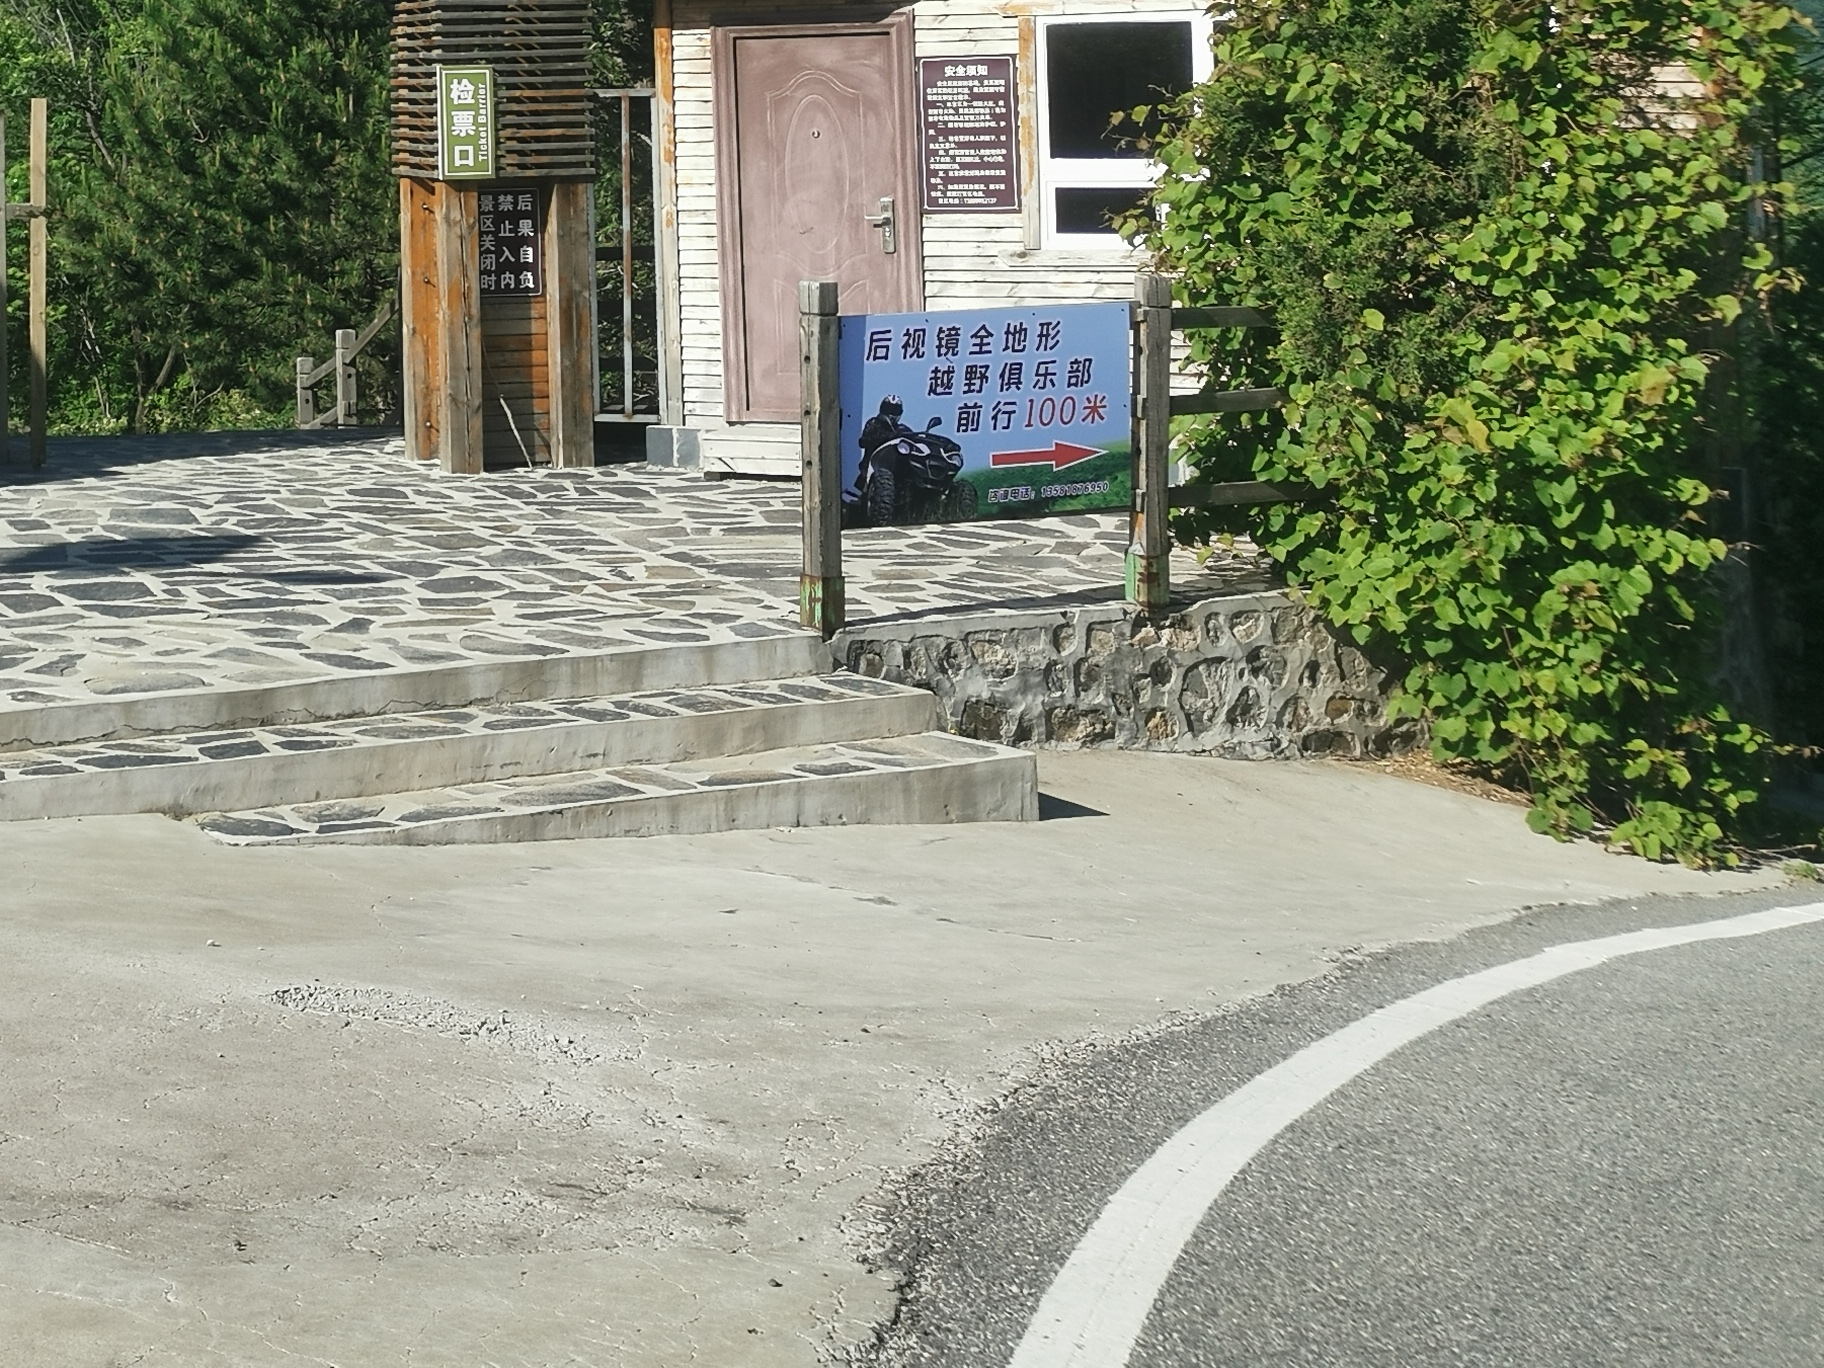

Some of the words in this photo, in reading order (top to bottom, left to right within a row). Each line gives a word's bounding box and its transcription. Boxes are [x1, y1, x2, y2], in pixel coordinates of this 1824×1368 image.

[450, 78, 476, 167] 检票口
[477, 83, 487, 123] Barrier
[478, 133, 488, 162] Ticket
[479, 194, 496, 291] 景区关闭时
[498, 194, 516, 290] 禁止入内
[517, 193, 535, 289] 后果自负
[866, 320, 1062, 362] 后视镜全地形
[927, 357, 1094, 397] 越野俱乐部
[956, 394, 1108, 433] 前行100米
